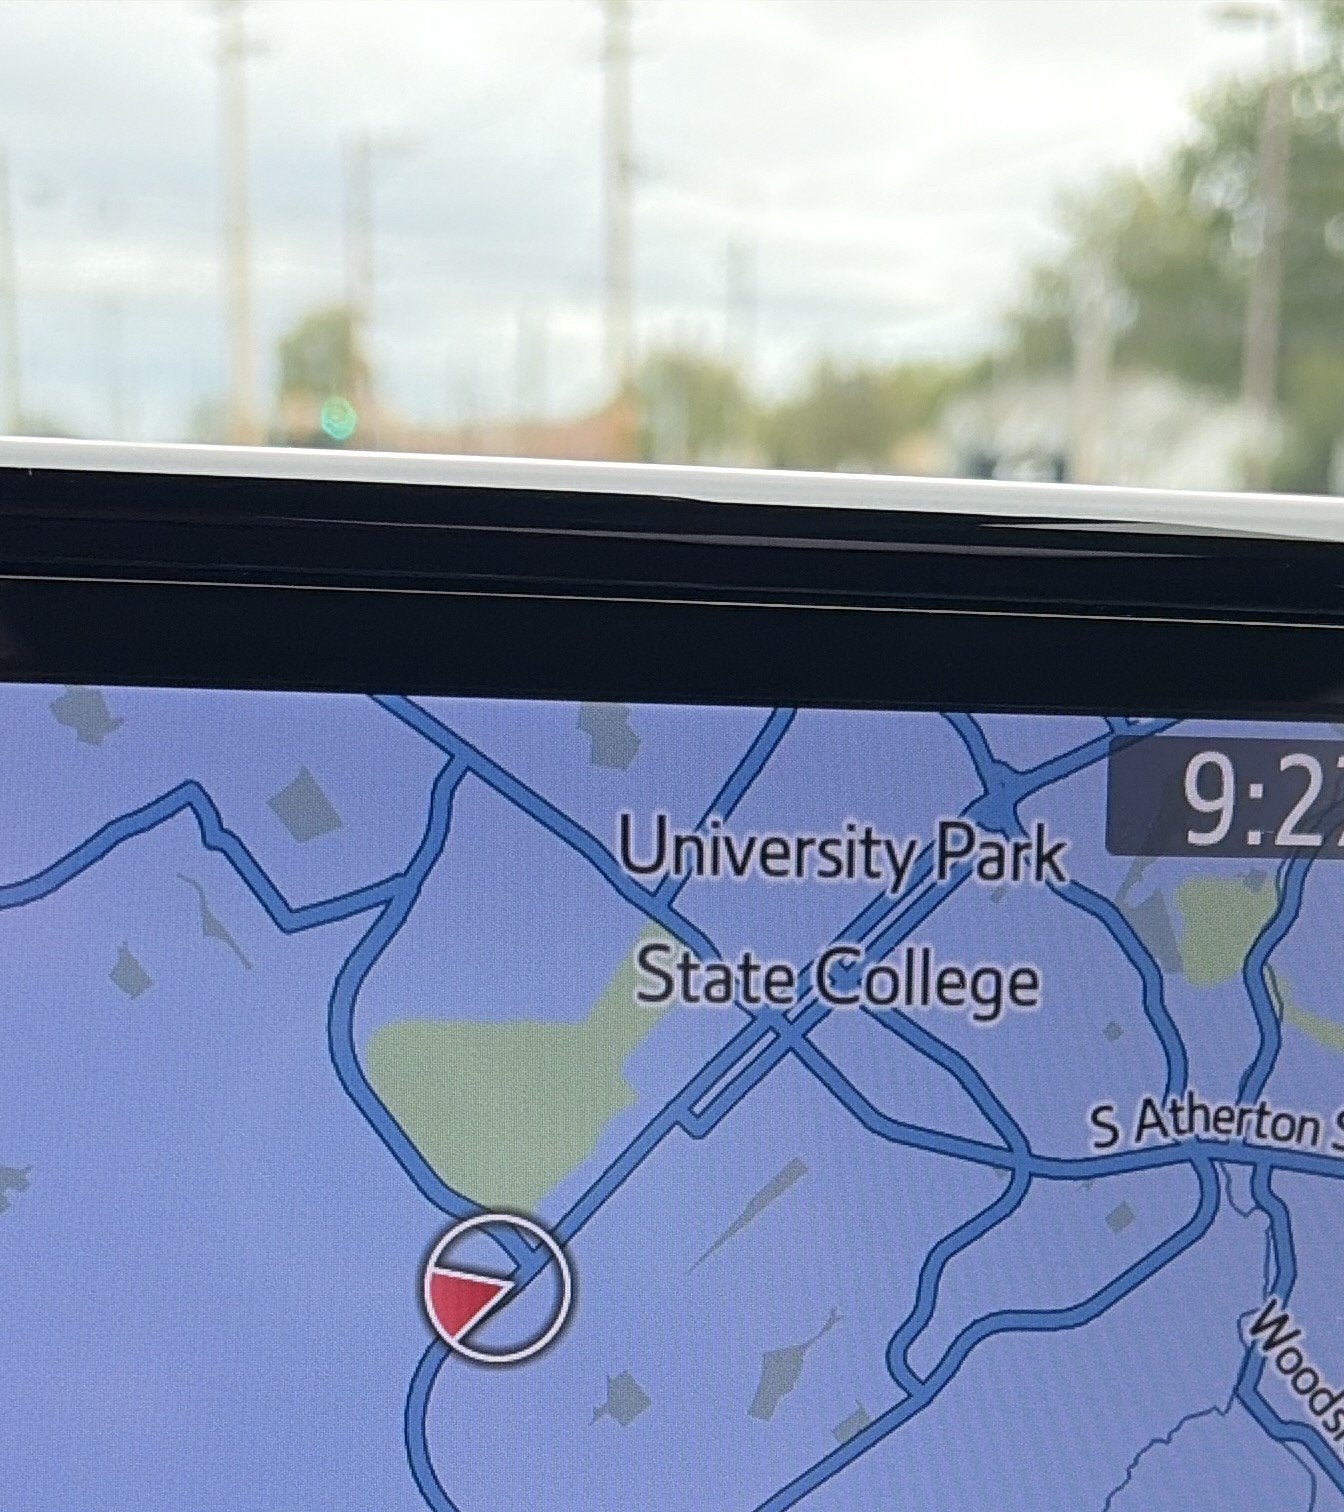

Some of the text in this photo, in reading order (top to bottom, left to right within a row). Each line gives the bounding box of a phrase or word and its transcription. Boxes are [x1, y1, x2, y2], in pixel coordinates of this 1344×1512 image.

[618, 812, 1068, 893] University Park
[636, 942, 1042, 1022] State College
[1090, 1104, 1120, 1148] S
[1134, 1095, 1322, 1147] Atherton
